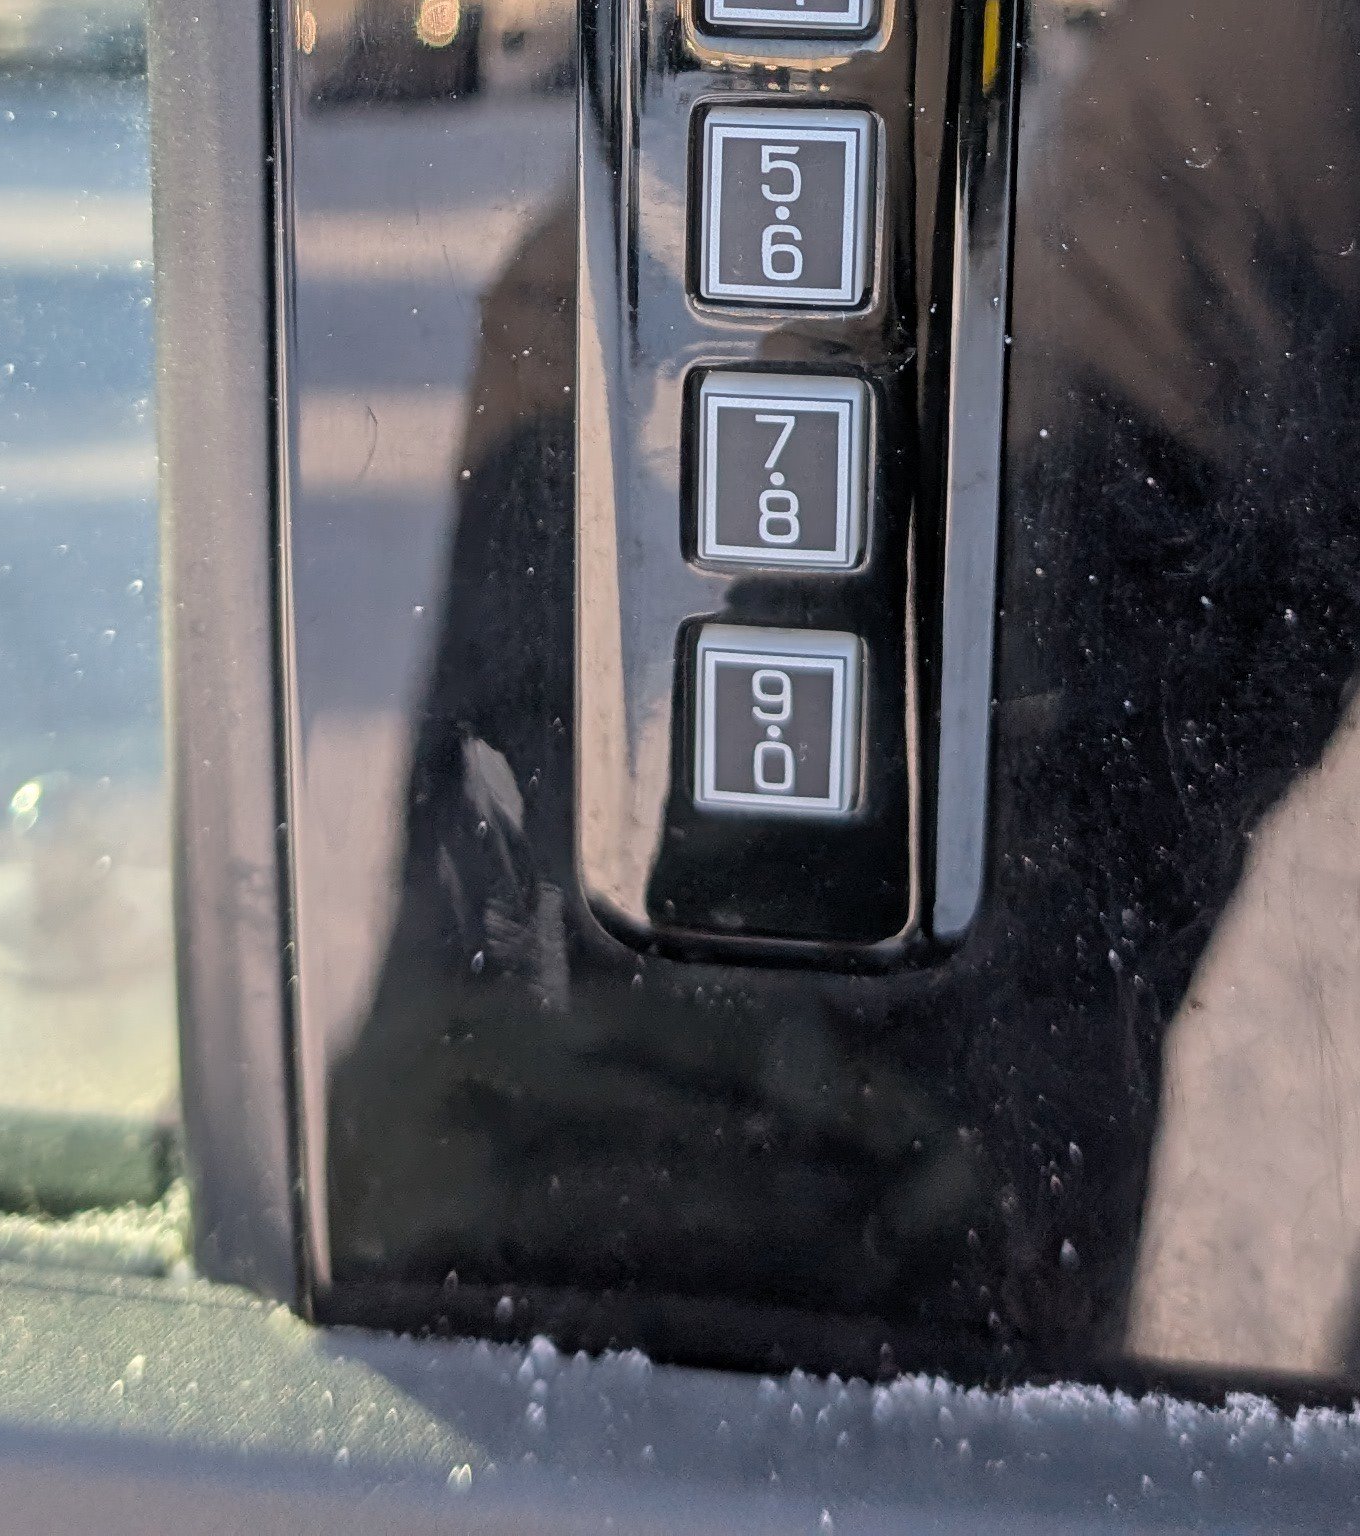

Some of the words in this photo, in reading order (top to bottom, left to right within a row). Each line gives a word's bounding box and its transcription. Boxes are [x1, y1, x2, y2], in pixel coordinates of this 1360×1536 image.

[760, 145, 802, 203] 5
[761, 224, 804, 281] 6
[754, 414, 796, 469] 7
[758, 489, 800, 545] 8
[751, 669, 792, 722] 9
[753, 740, 794, 791] 0
